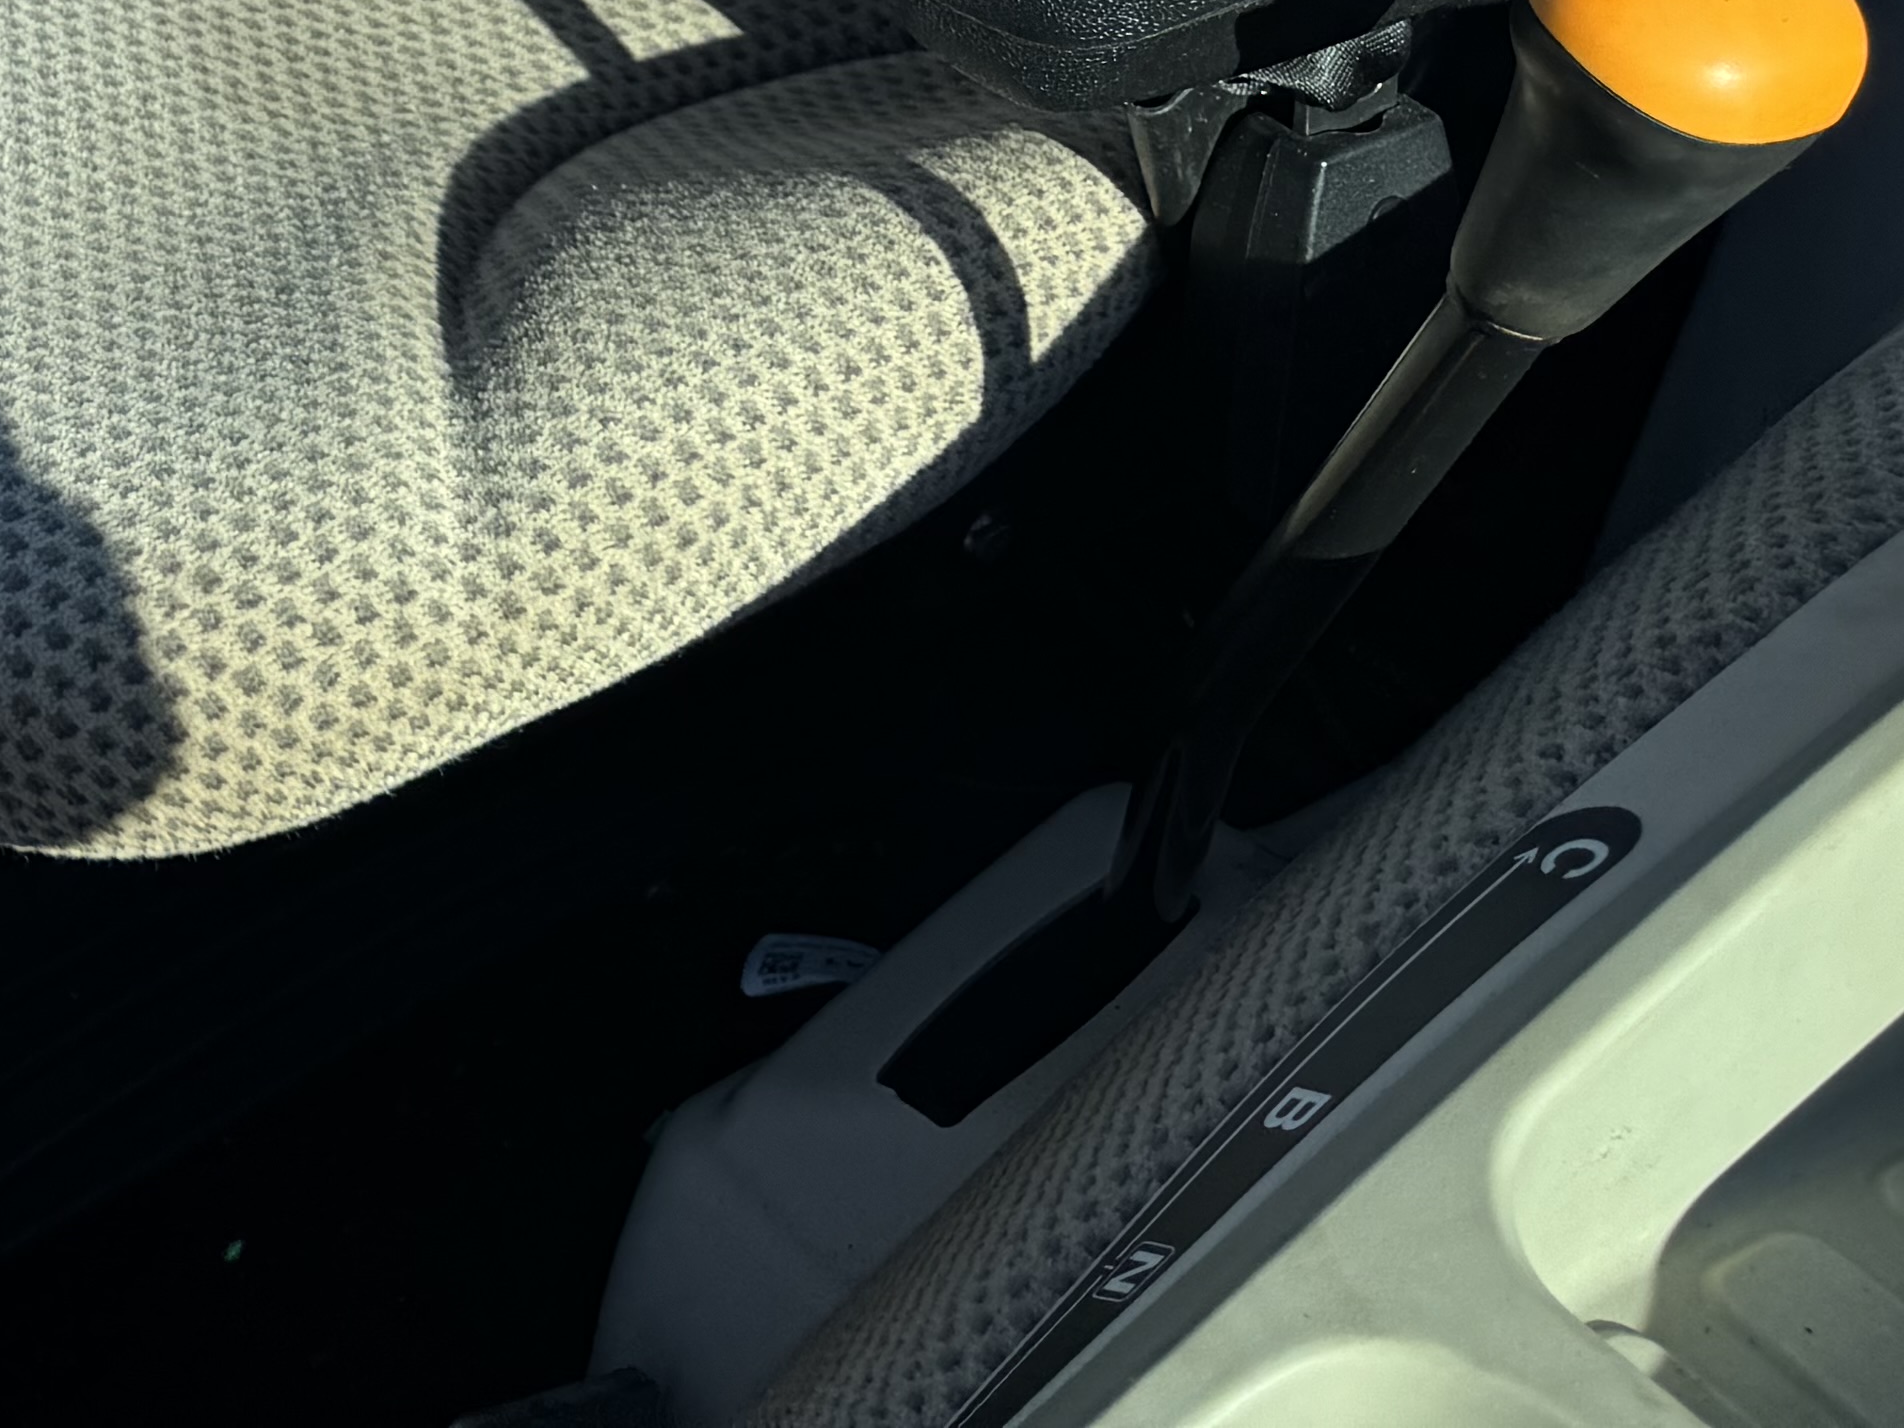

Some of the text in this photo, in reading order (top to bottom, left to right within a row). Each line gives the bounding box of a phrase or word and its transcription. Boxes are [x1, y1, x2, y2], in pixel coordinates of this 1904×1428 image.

[1540, 838, 1610, 880] C
[1263, 1086, 1332, 1132] B
[1103, 1250, 1165, 1294] N
